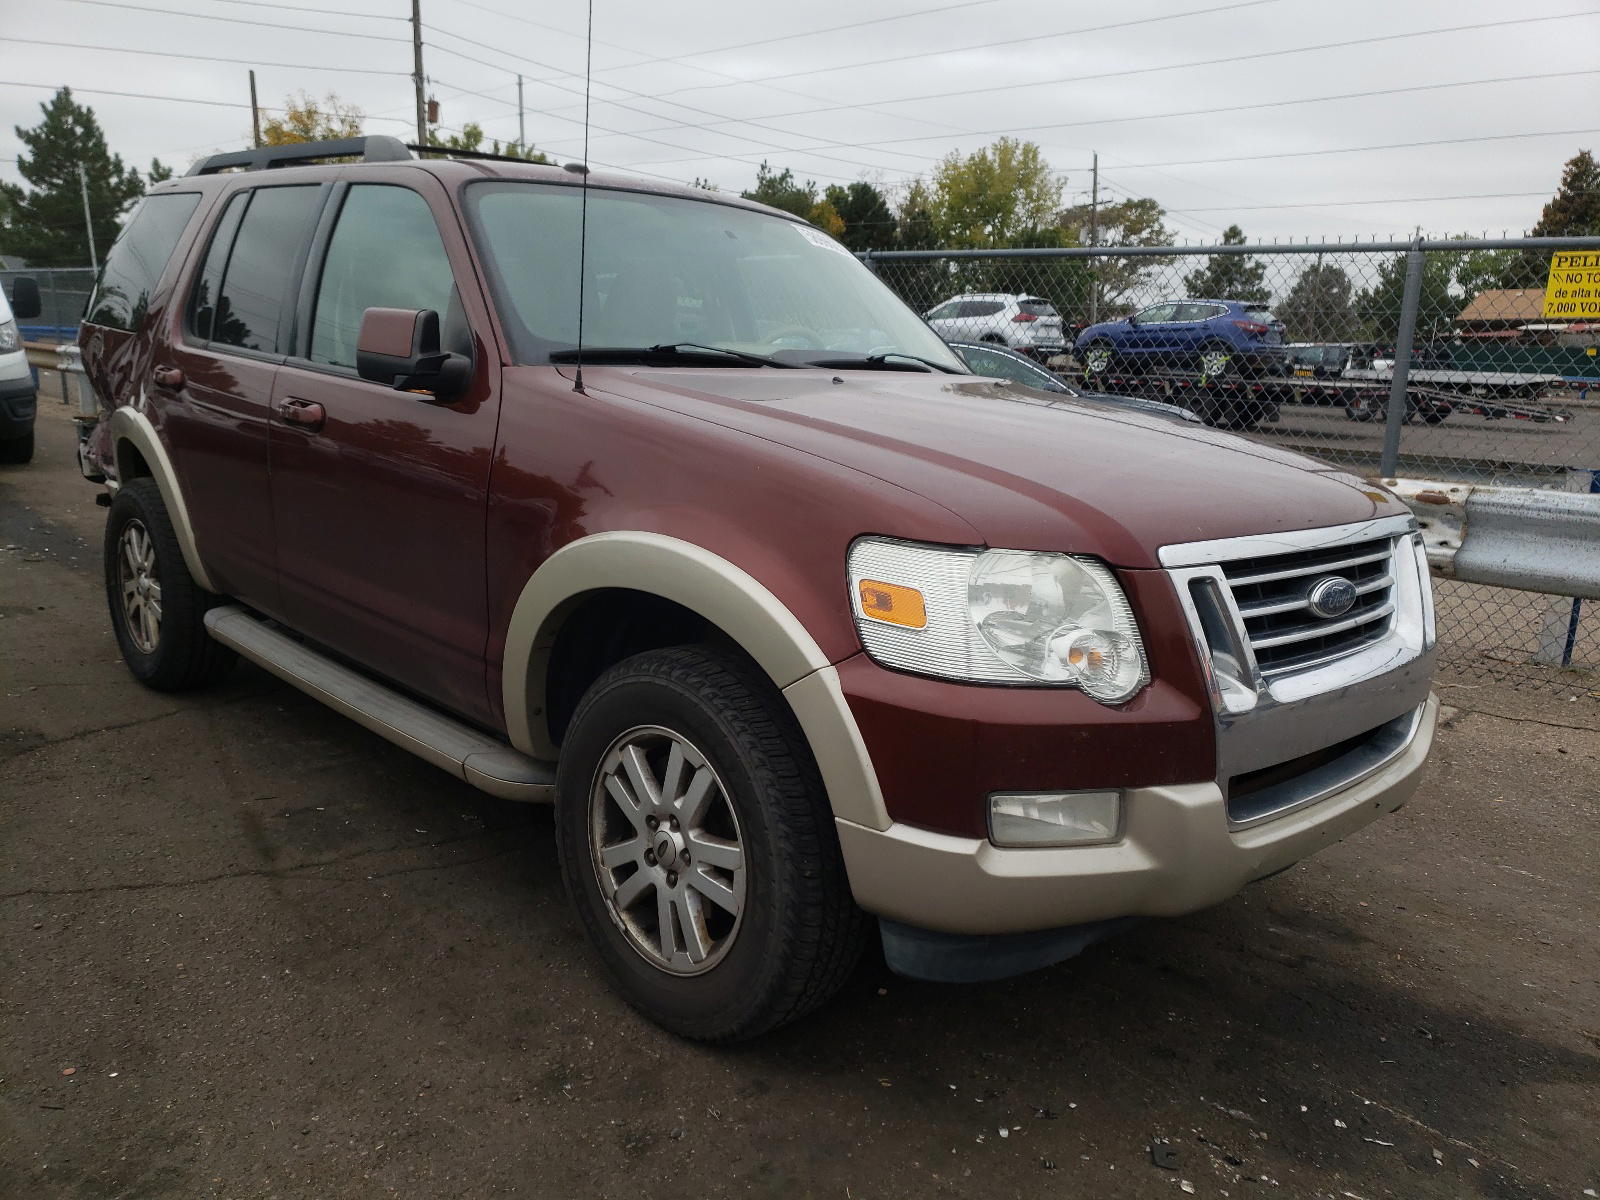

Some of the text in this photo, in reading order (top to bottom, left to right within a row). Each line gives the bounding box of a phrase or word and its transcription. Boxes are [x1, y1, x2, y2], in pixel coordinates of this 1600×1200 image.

[1566, 273, 1583, 283] NO
[1555, 288, 1568, 298] de
[1571, 288, 1591, 298] alta
[1547, 302, 1576, 314] 7,000
